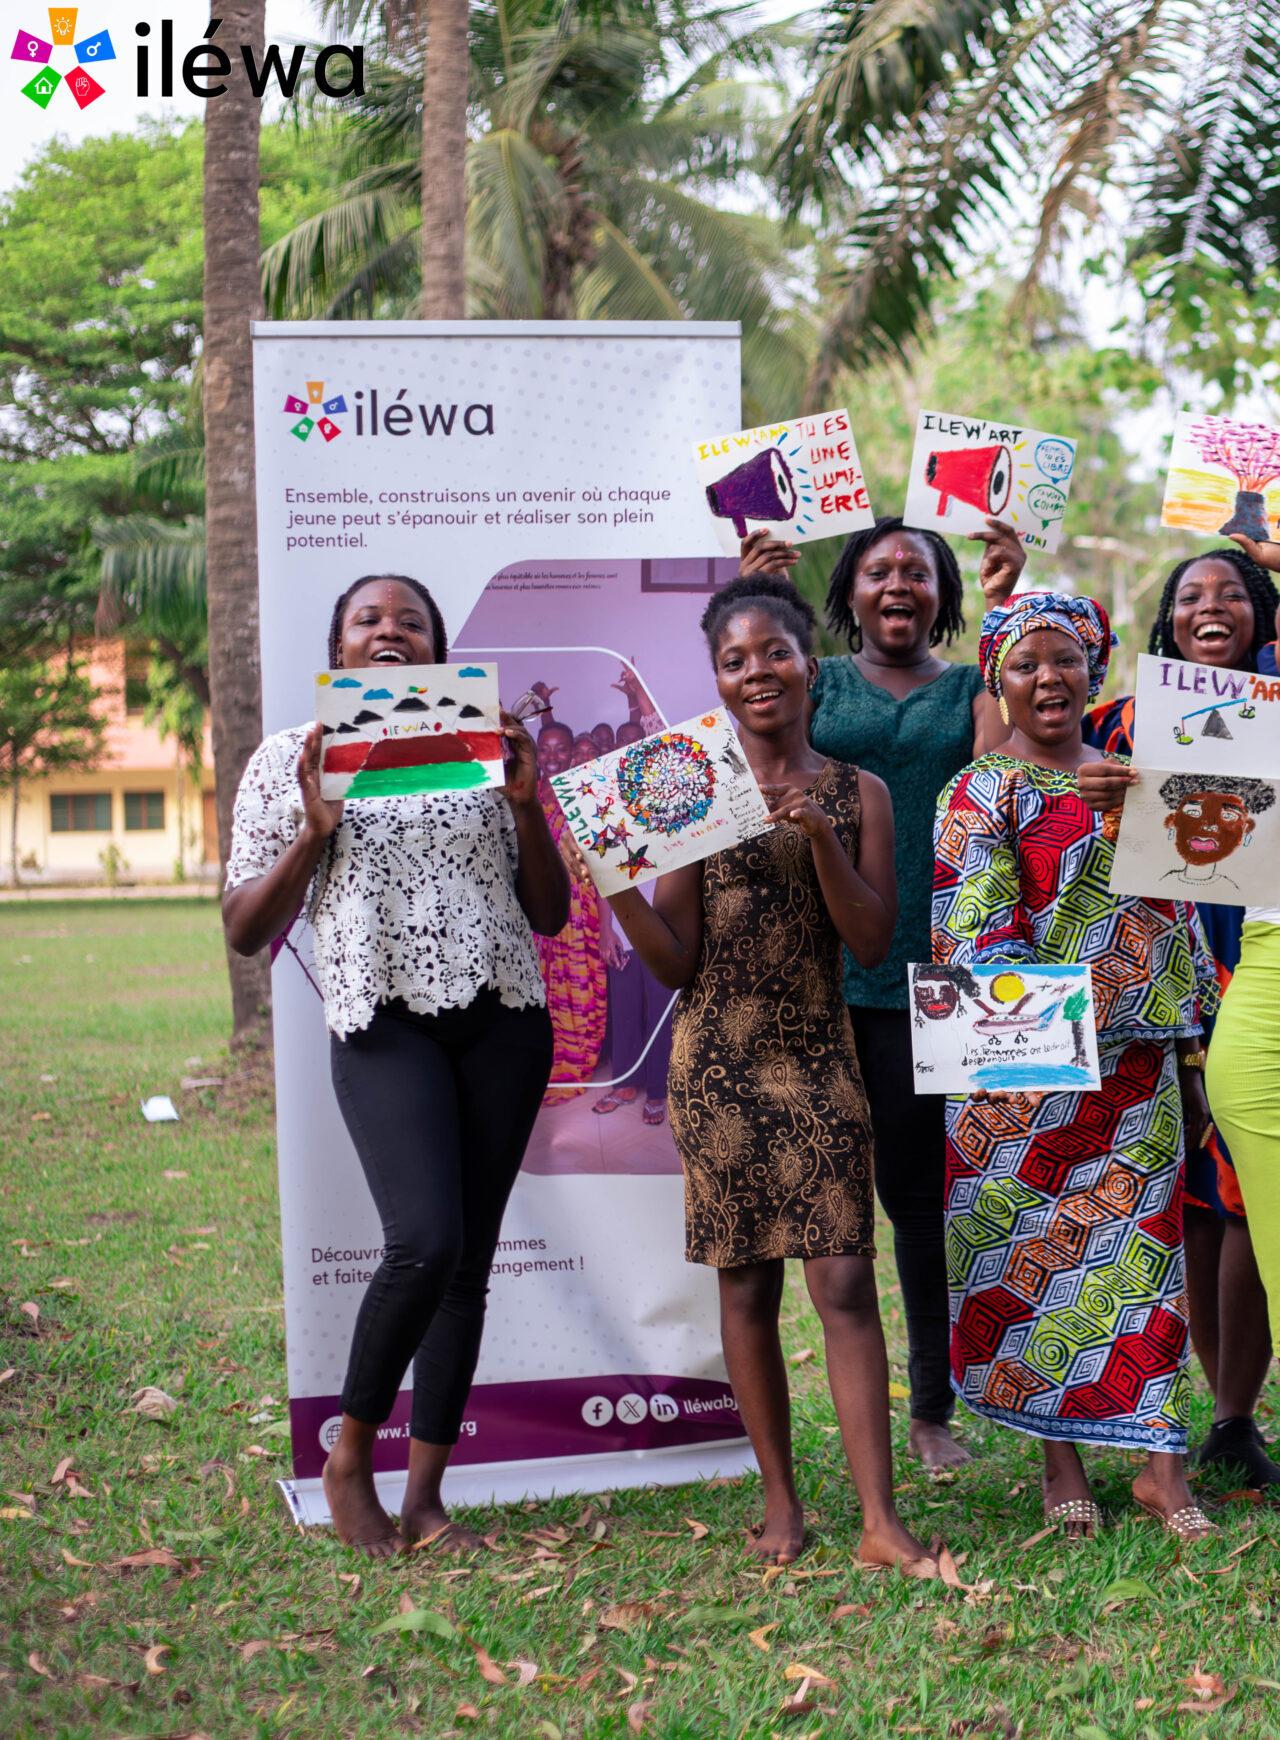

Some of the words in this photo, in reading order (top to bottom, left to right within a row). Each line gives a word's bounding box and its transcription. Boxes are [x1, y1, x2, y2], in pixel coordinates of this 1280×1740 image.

[354, 388, 495, 436] iléwa
[824, 415, 848, 436] ES
[810, 441, 851, 465] UNE
[285, 488, 374, 505] Ensemble,
[378, 488, 491, 504] construisons
[496, 490, 517, 503] un
[522, 488, 576, 503] avenir
[581, 487, 603, 502] où
[608, 486, 671, 505] chaque
[286, 511, 337, 529] jeune
[342, 511, 381, 530] peut
[484, 511, 502, 525] et
[507, 508, 571, 525] réaliser
[577, 511, 607, 524] son
[613, 508, 655, 528] plein
[285, 532, 368, 550] potentiel.
[311, 1246, 386, 1263] Découvre
[312, 1271, 331, 1286] et
